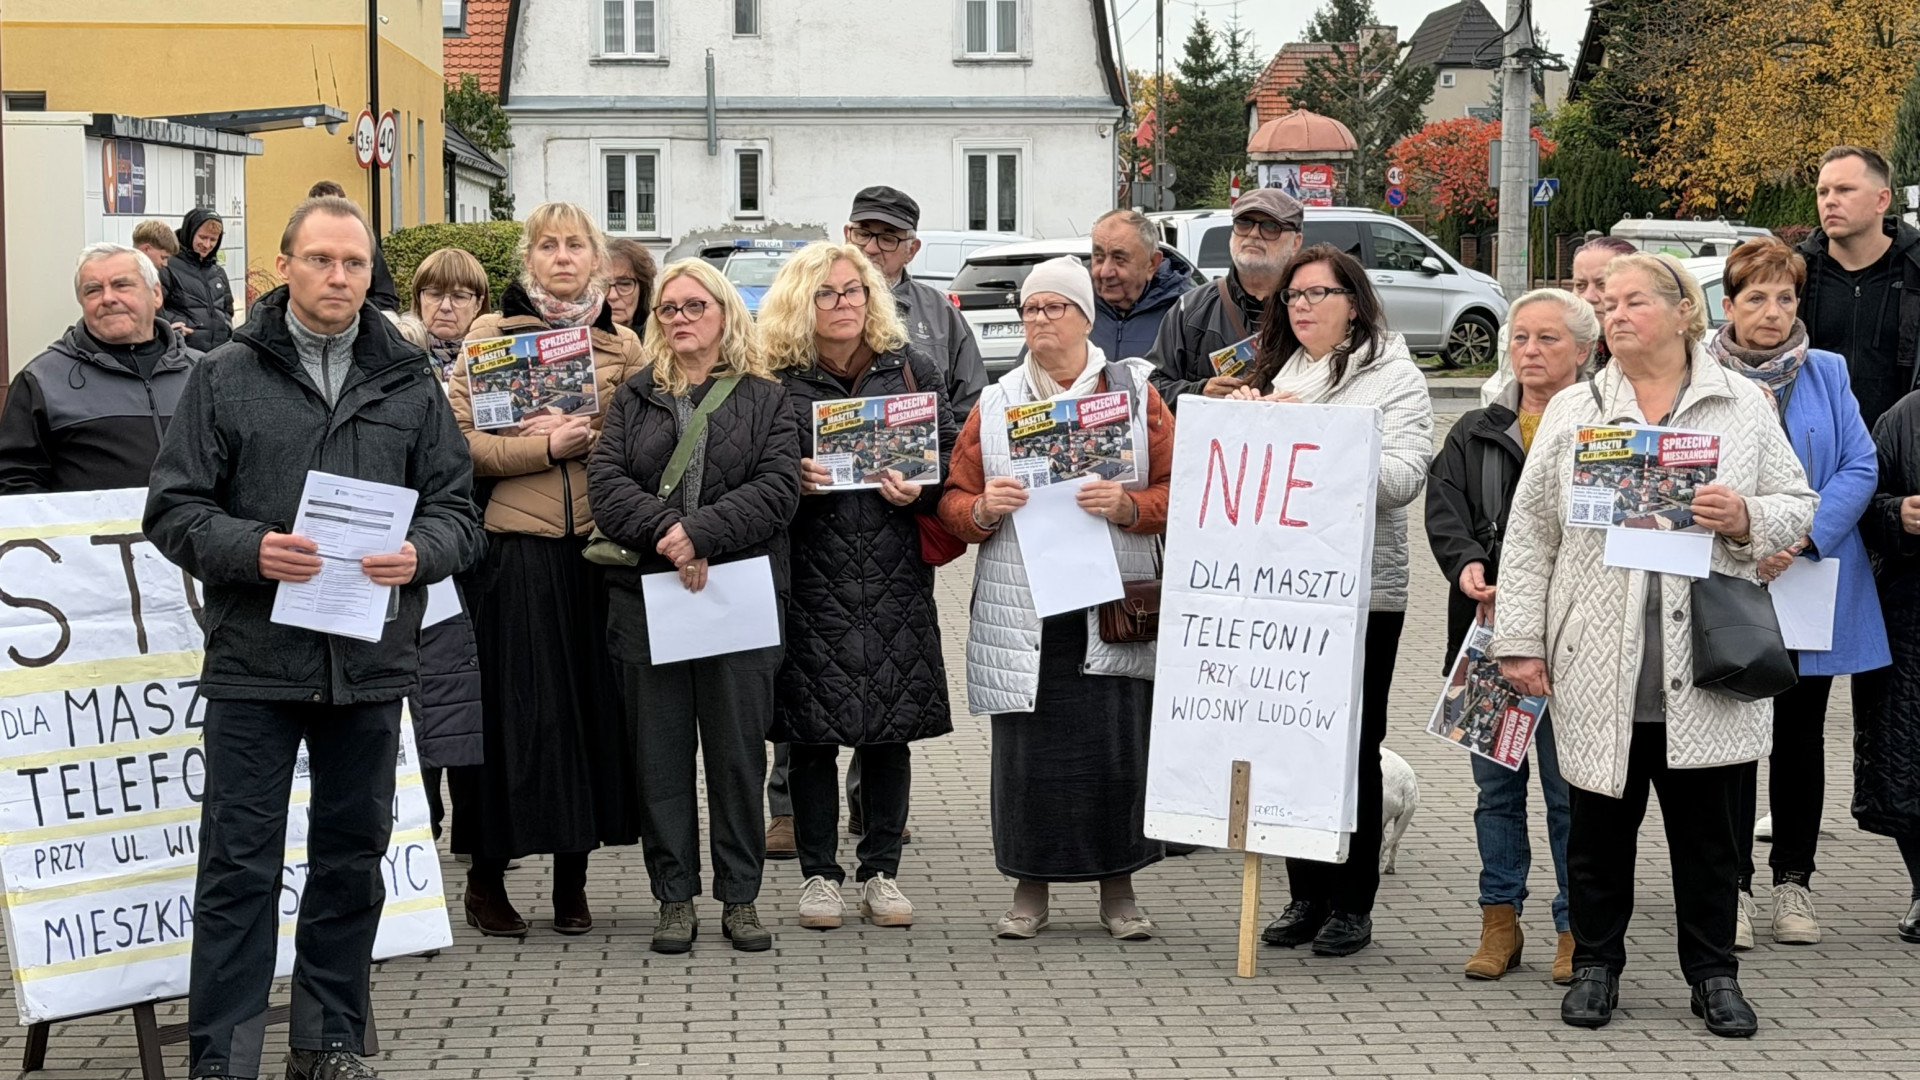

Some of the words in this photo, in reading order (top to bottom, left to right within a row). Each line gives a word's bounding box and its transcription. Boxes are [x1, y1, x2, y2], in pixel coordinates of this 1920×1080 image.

[380, 128, 394, 154] 40
[990, 324, 1004, 335] PP
[540, 330, 581, 350] SPRZECIW
[467, 344, 481, 357] NIE
[478, 349, 506, 363] MASZTU
[818, 405, 831, 418] NIE
[888, 396, 928, 414] SPRZECIW
[1006, 408, 1021, 421] NIE
[1080, 395, 1121, 414] SPRZECIW
[827, 411, 854, 424] MASZTU
[1018, 412, 1046, 428] MASZTU
[1578, 429, 1594, 441] NIE
[1663, 436, 1712, 450] SPRZECIW
[1588, 440, 1622, 451] MASZTU
[1199, 438, 1320, 528] NIE
[1190, 560, 1240, 593] DLA
[1254, 567, 1355, 598] MASZTU
[0, 532, 205, 667] ST
[1181, 613, 1329, 656] TELEFONII
[1197, 660, 1238, 688] PRZY
[1250, 667, 1311, 693] ULICY
[1, 705, 51, 740] DLA
[64, 680, 206, 747] MASZ
[1171, 696, 1249, 723] WIOSNY
[1258, 699, 1337, 731] LUDÓW
[1510, 713, 1531, 764] SPRZECIW
[17, 747, 206, 827] TELEFO
[34, 841, 86, 879] PRZY
[111, 834, 149, 863] UL.
[44, 895, 194, 965] MIESZKA
